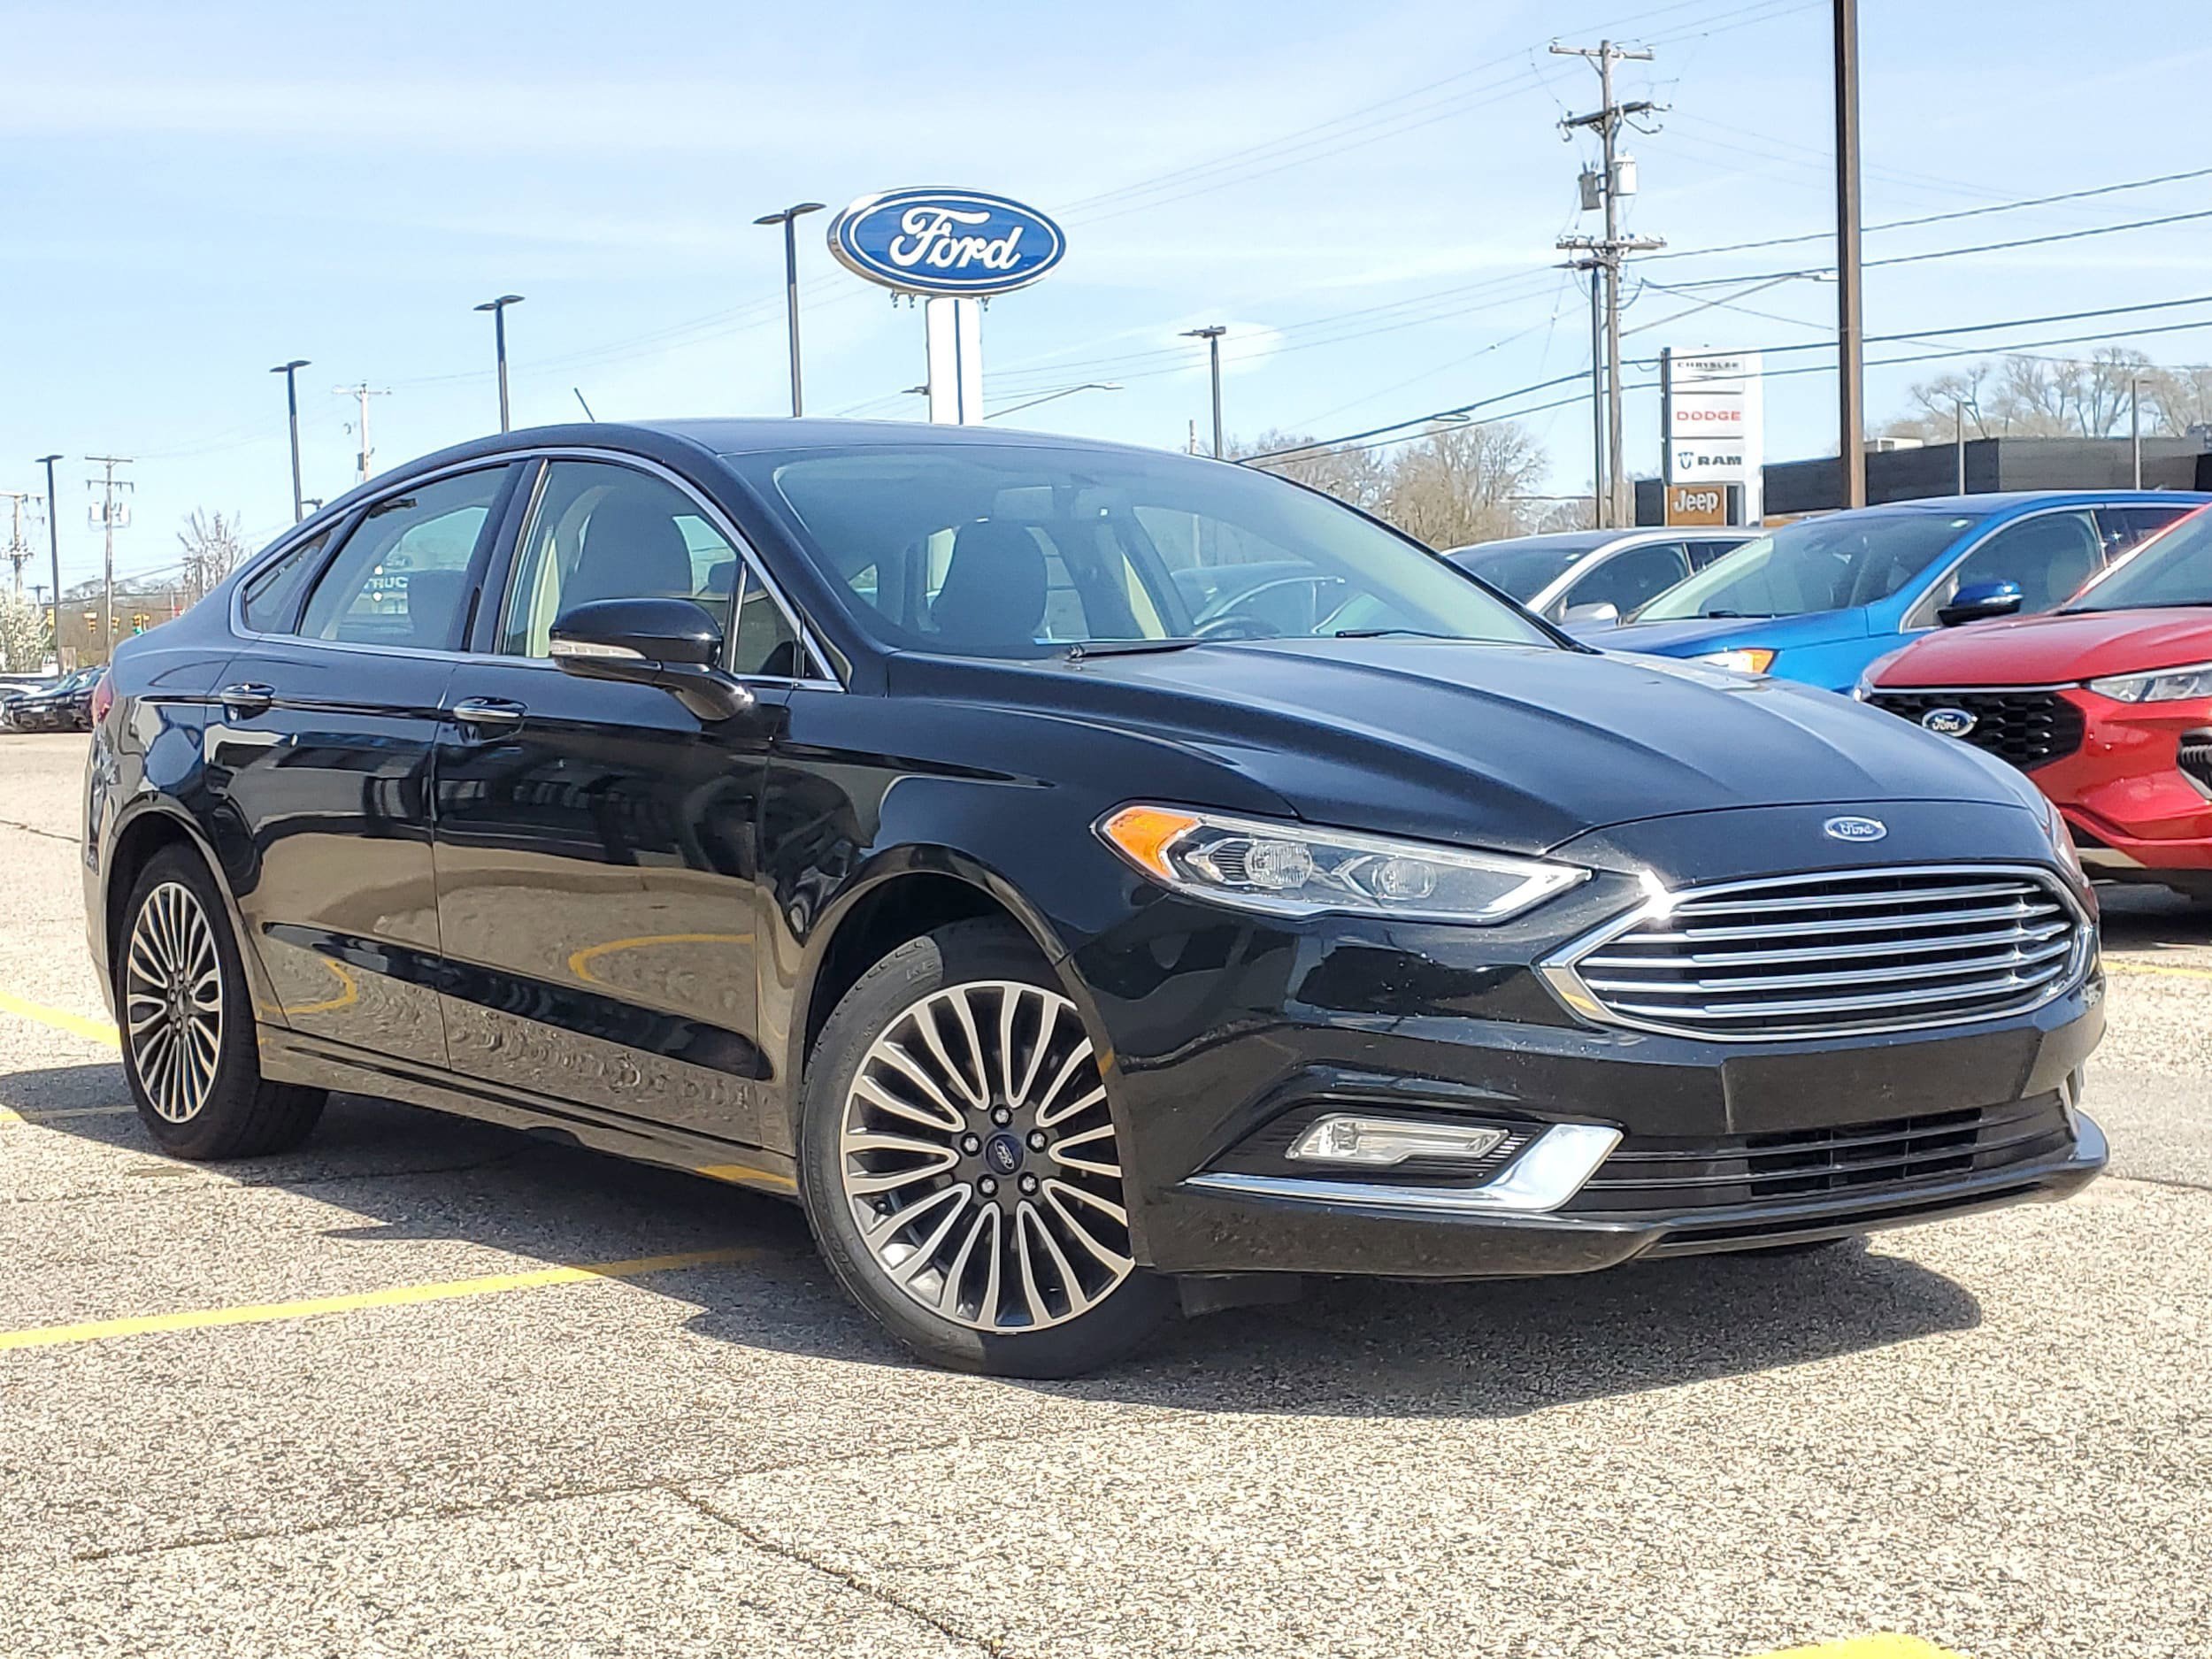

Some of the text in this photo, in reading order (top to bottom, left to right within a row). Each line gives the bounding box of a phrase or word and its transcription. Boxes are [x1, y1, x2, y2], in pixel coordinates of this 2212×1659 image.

[889, 206, 1025, 270] Ford
[1677, 411, 1742, 421] DODGE
[1697, 456, 1742, 465] RAM
[1673, 489, 1719, 515] Jeep
